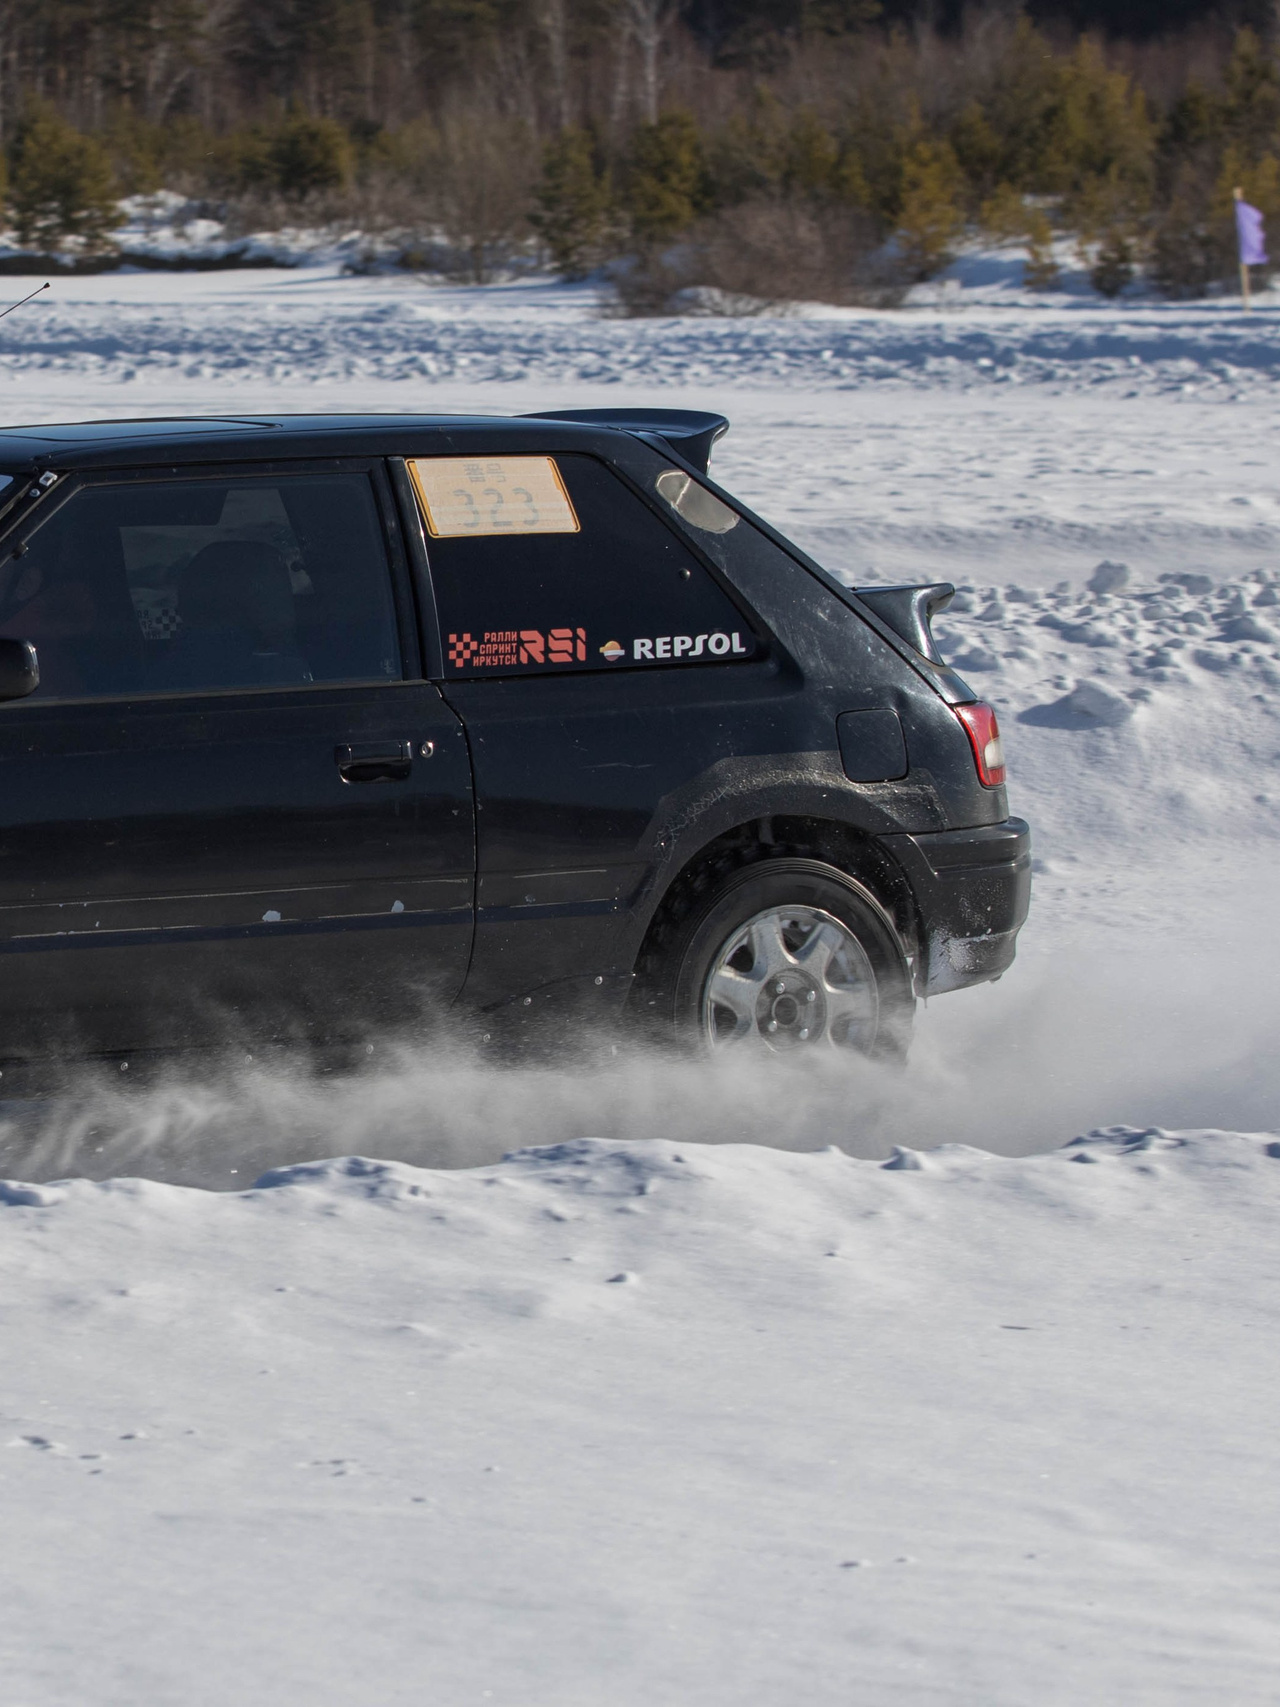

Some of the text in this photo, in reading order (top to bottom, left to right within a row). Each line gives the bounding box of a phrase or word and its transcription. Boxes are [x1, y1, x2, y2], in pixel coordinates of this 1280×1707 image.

[484, 631, 517, 642] РАЛЛИ
[479, 643, 517, 654] СПРИНТ
[633, 632, 746, 660] REPSOL
[472, 654, 517, 667] ИРКУТСК
